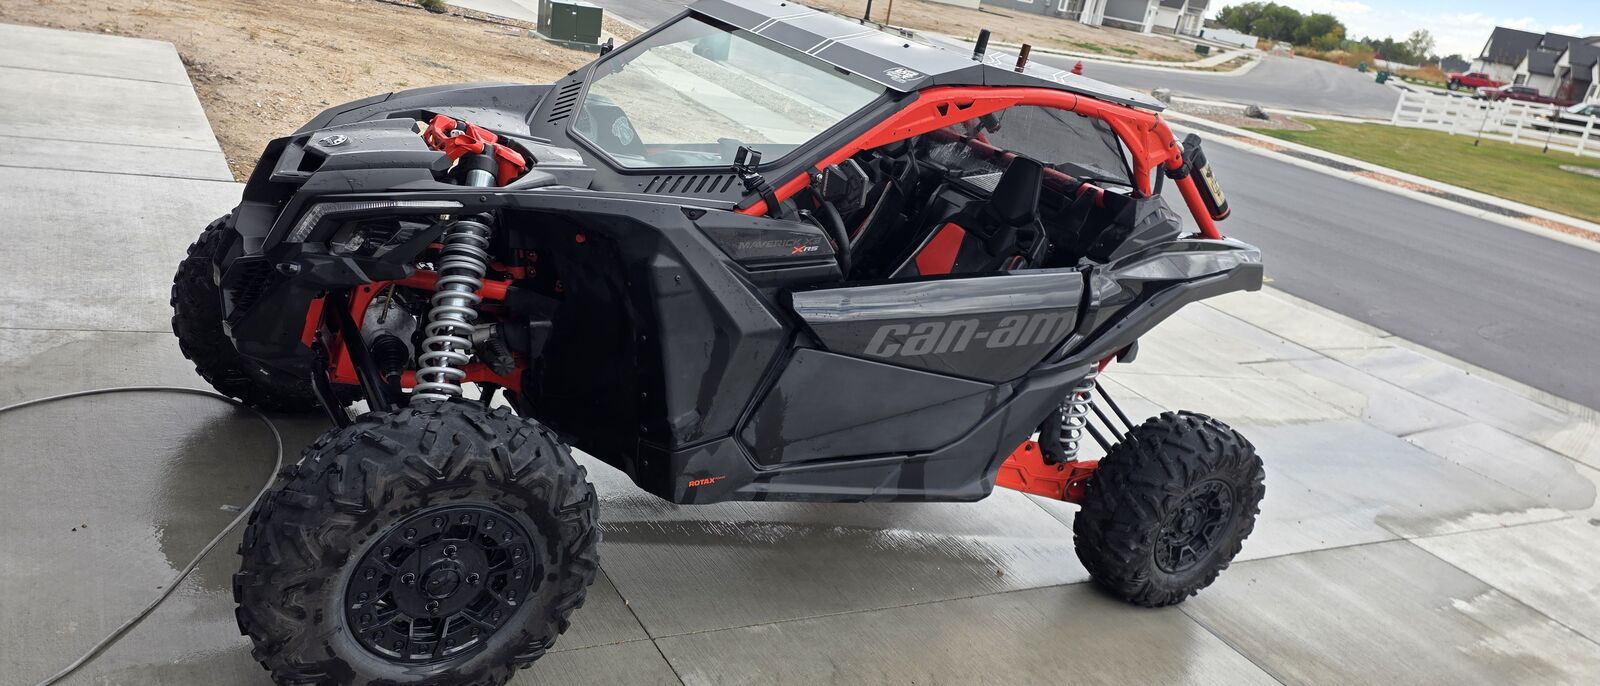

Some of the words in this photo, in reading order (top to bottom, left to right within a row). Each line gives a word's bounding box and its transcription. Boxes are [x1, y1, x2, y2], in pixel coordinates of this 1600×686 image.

[738, 239, 802, 249] MAVERICK
[863, 311, 1076, 358] can-am
[688, 477, 715, 487] ROTAX
